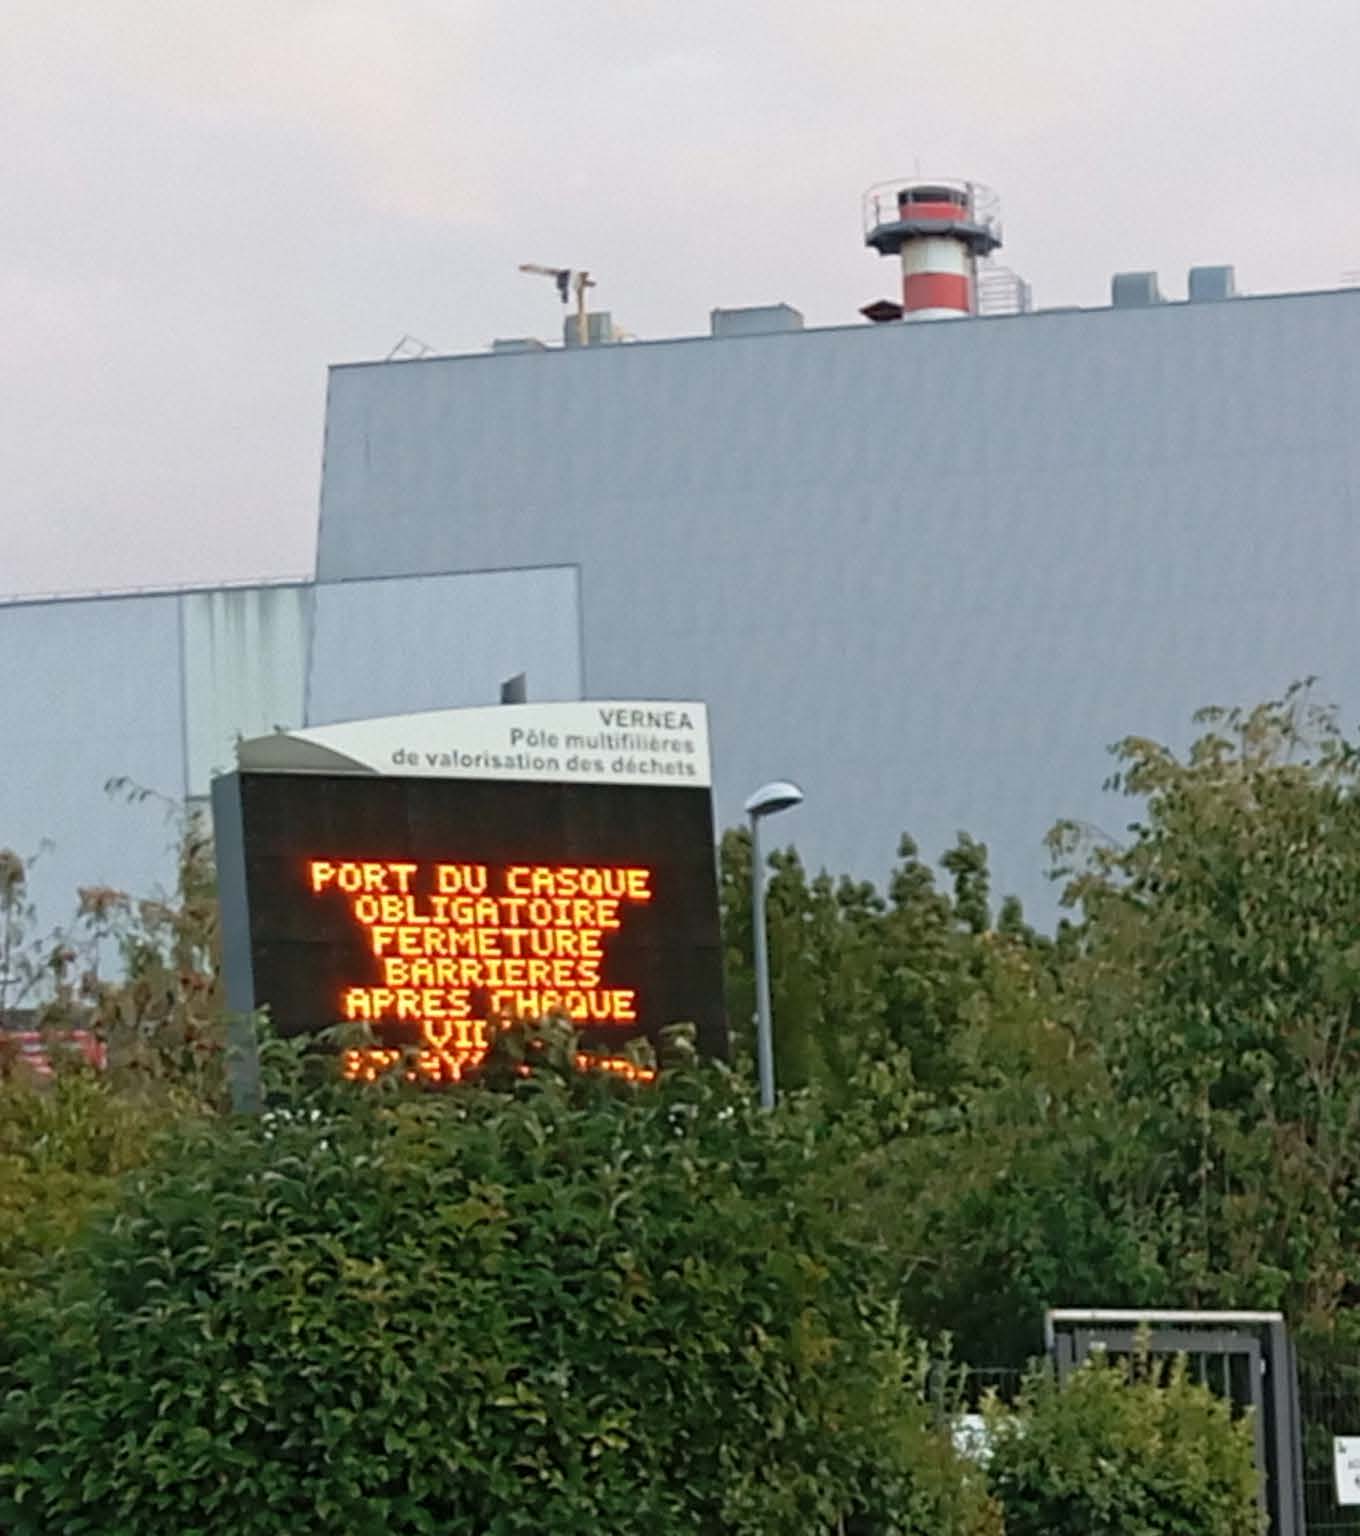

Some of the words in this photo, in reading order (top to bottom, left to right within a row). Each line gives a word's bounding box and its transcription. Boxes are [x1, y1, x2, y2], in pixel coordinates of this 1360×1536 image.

[599, 708, 695, 731] VERNEA
[510, 728, 559, 748] Pôle
[565, 733, 696, 755] multifilières
[391, 748, 419, 766] de
[426, 750, 560, 772] valorisation
[566, 755, 605, 773] des
[611, 756, 697, 778] déchets
[310, 861, 418, 892] PORT
[437, 864, 488, 894] DU
[506, 866, 652, 898] CASQUE
[354, 895, 621, 928] OBLIGATOIRE
[371, 926, 605, 958] FERMETURE
[383, 957, 601, 988] BARRIERES
[345, 988, 472, 1019] APRES
